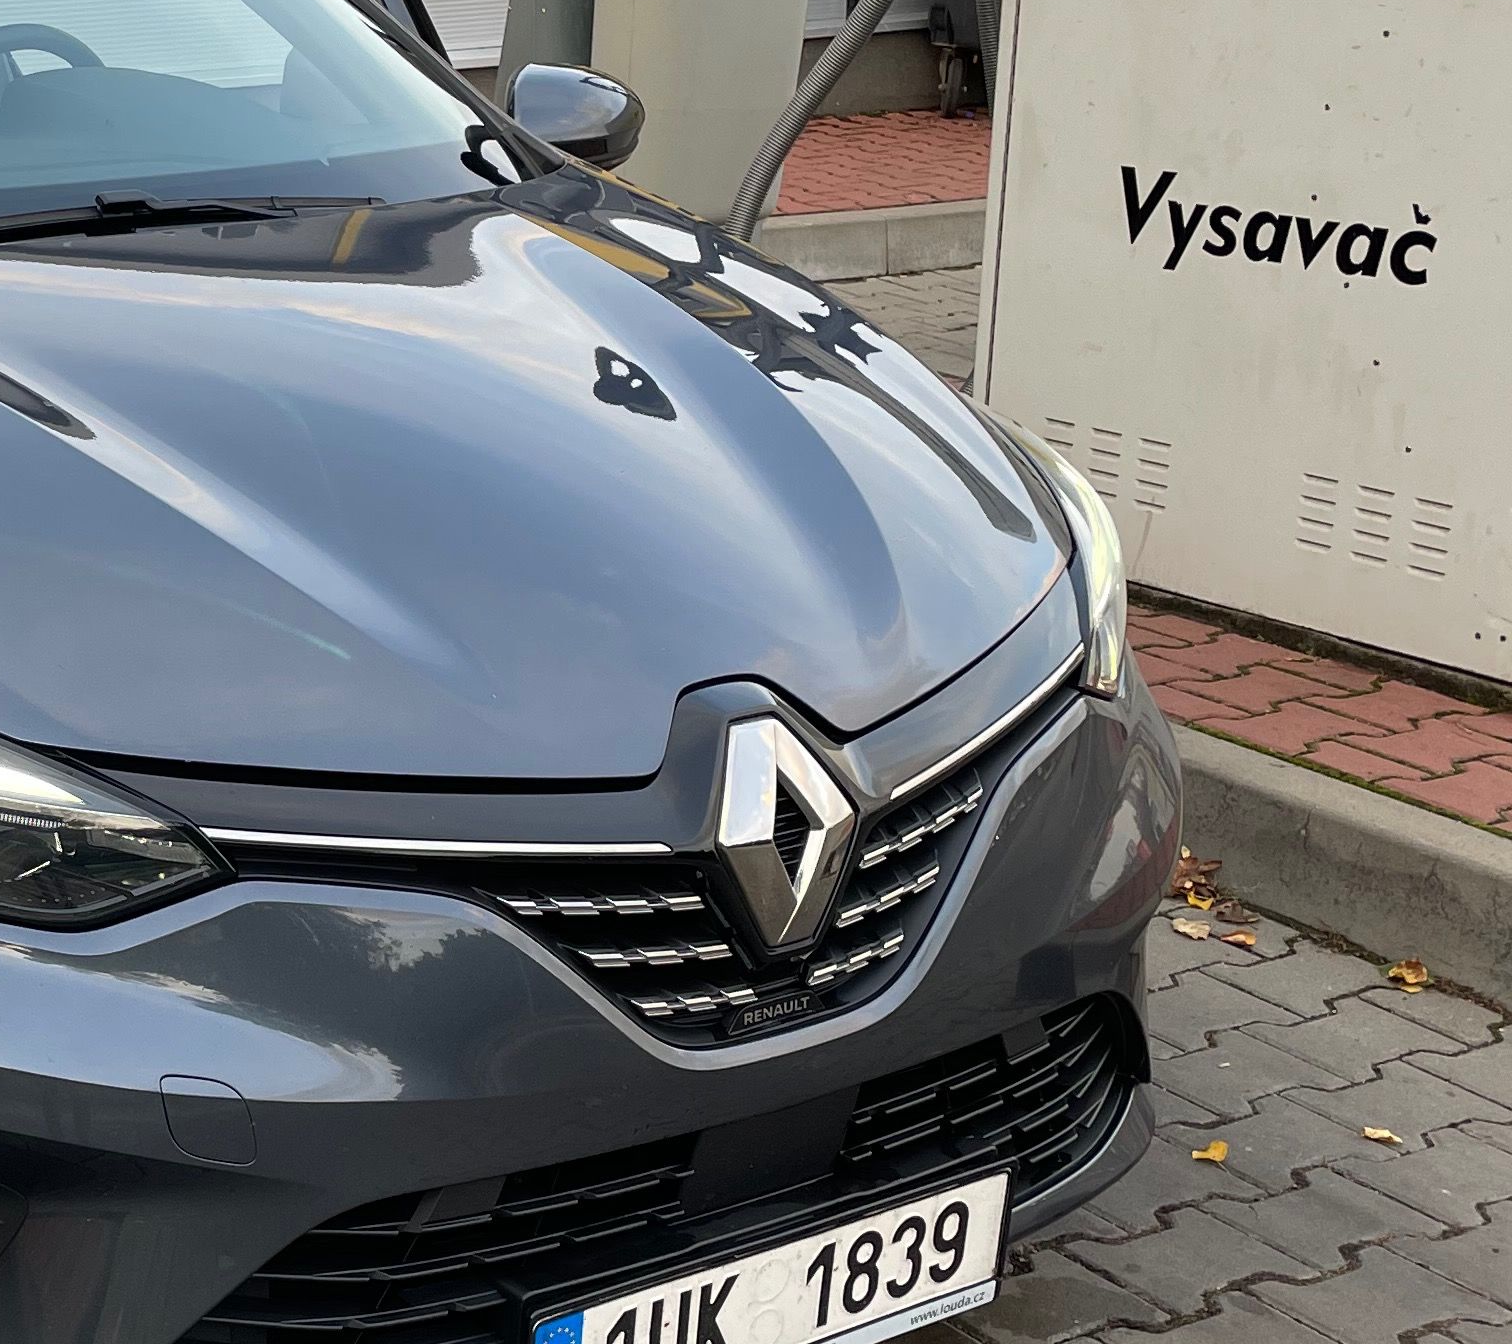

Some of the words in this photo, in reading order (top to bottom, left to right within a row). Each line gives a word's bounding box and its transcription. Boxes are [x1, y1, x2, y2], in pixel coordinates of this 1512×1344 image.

[1120, 165, 1438, 285] Vysavač
[743, 996, 810, 1026] RENAULT
[805, 1200, 970, 1329] 1839
[909, 1290, 986, 1326] www.louda.cz
